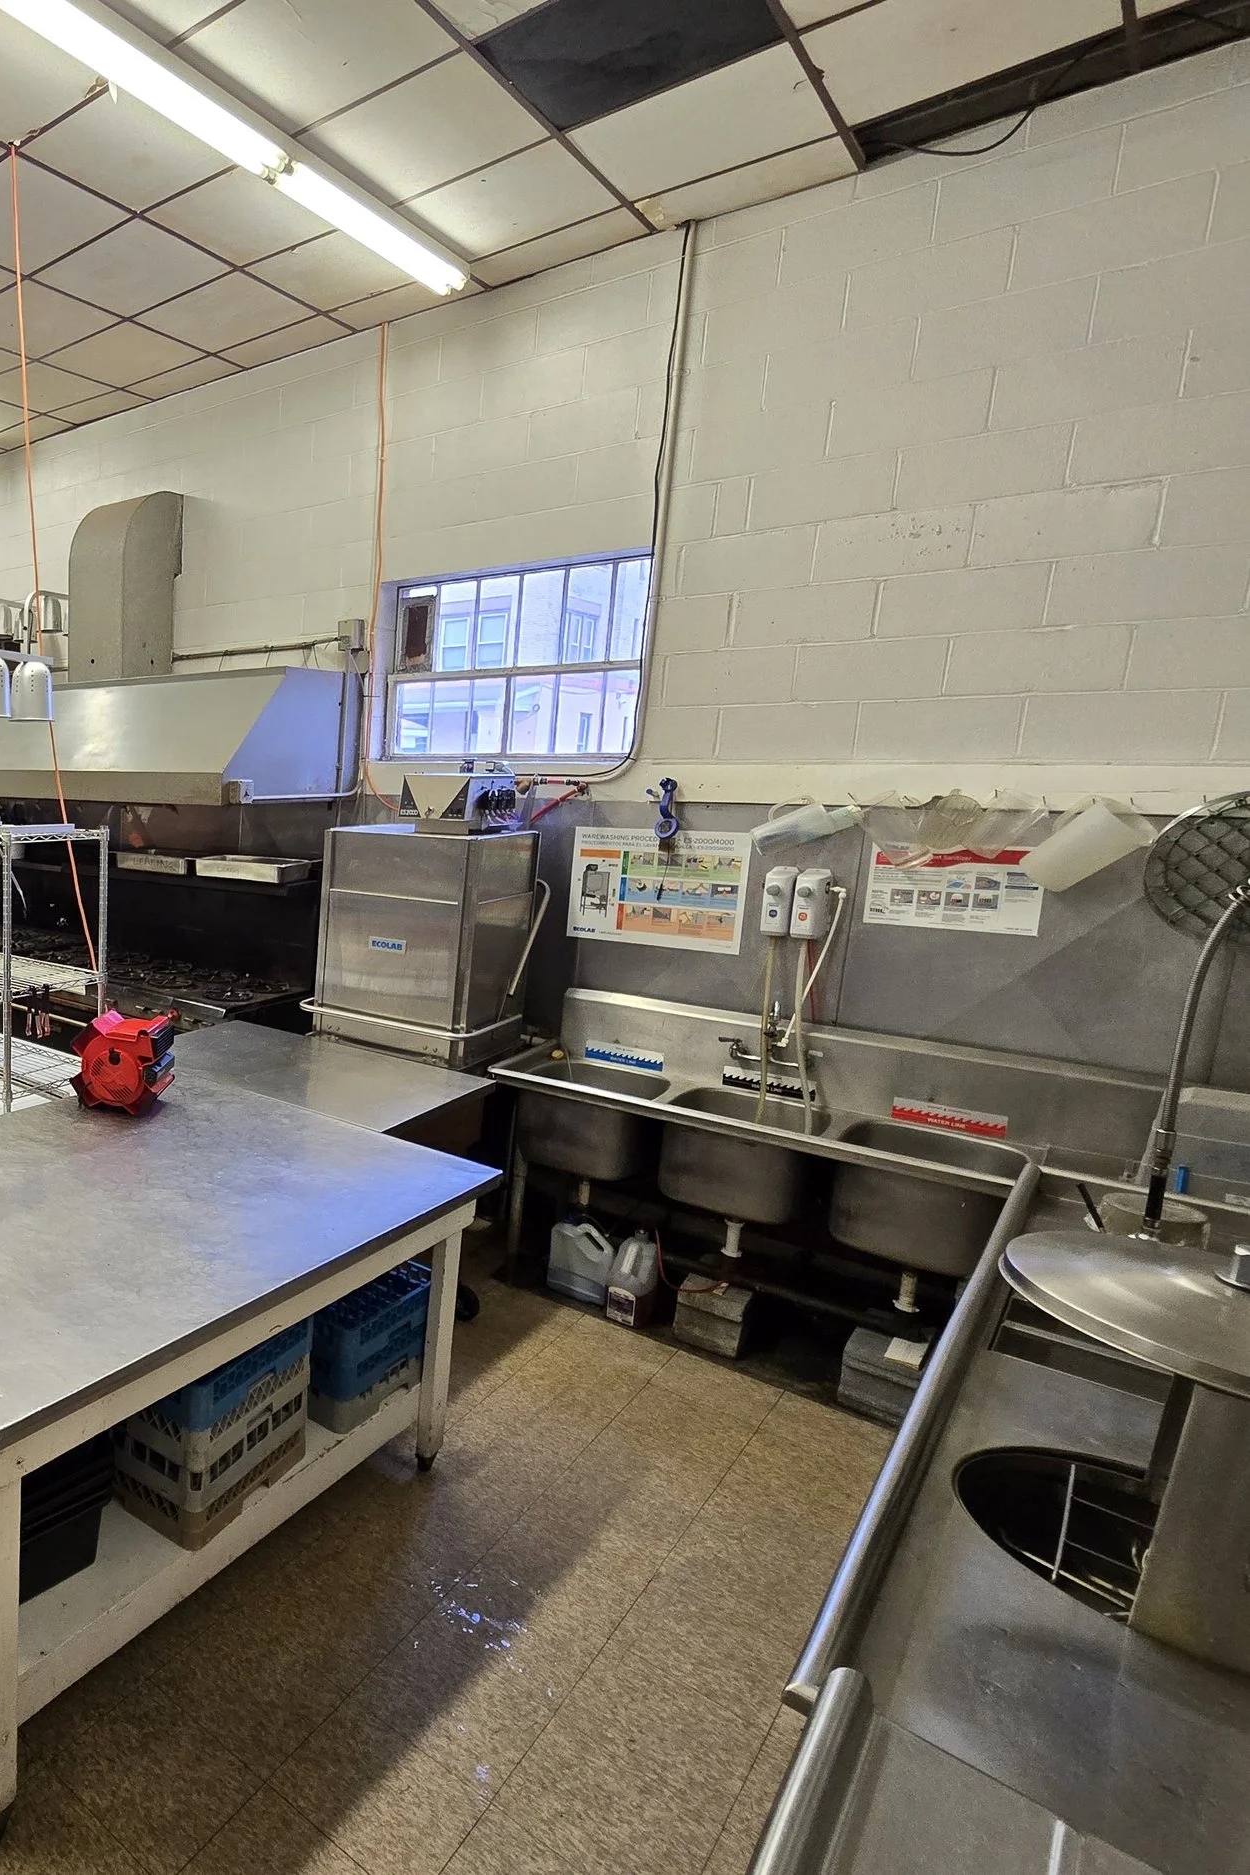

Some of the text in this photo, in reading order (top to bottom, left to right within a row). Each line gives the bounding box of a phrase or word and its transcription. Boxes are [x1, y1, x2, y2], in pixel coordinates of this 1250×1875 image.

[582, 833, 630, 841] WAREWASHING
[372, 940, 403, 951] ECOLAB
[927, 1117, 966, 1130] WATER LINE
